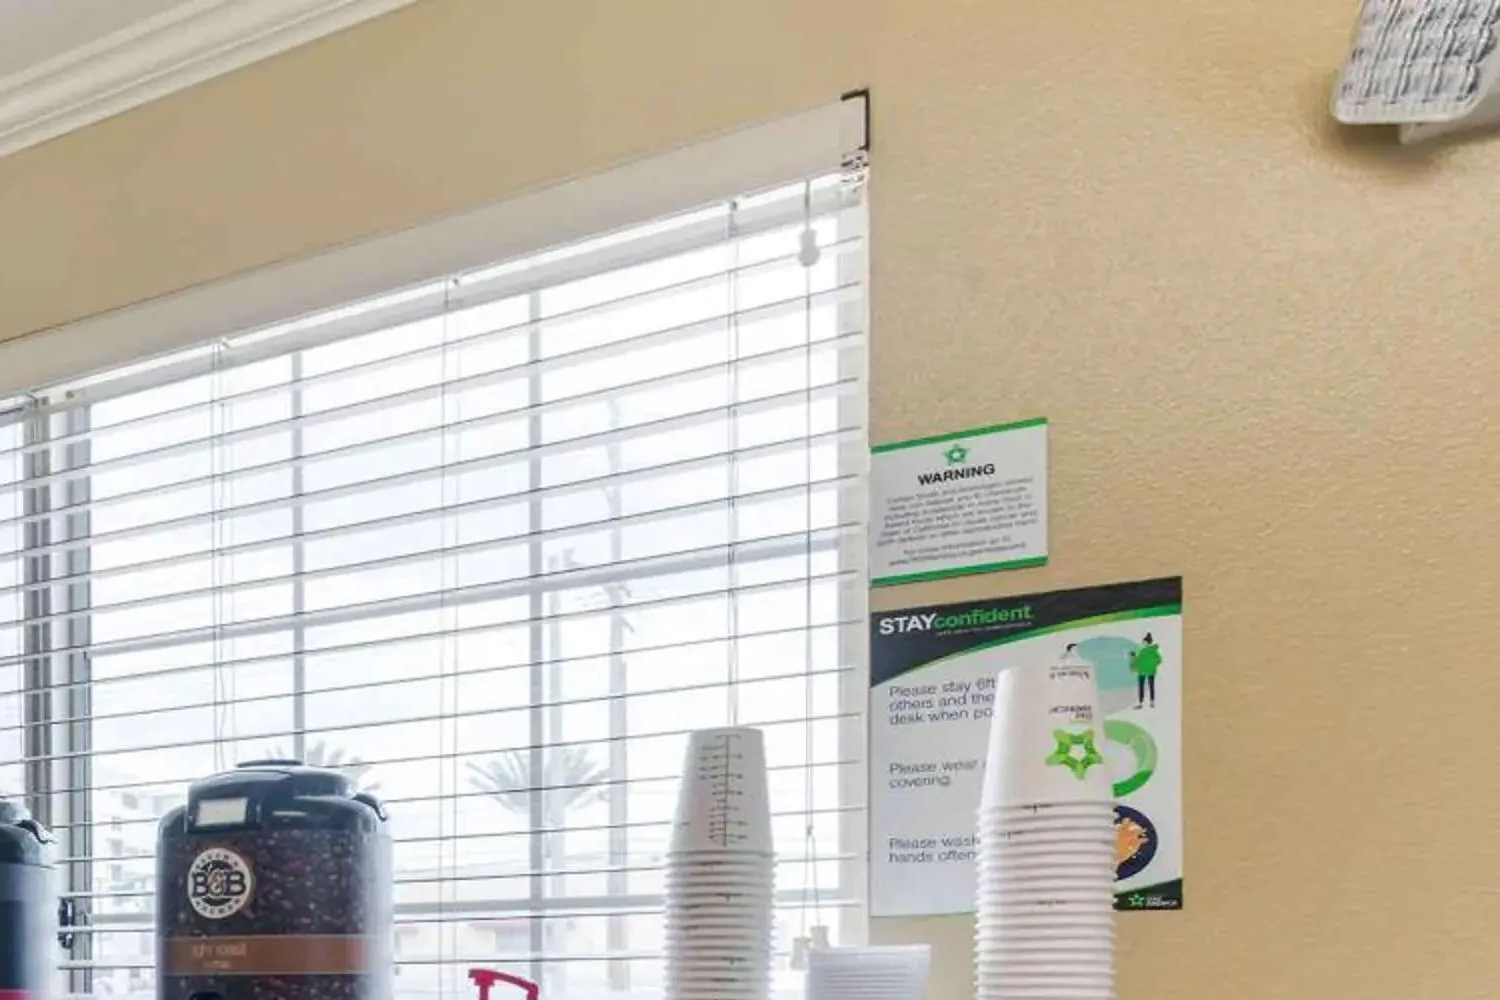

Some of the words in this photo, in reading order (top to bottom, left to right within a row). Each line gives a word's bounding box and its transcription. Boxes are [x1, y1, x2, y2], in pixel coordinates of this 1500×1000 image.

[918, 464, 996, 486] WARNING
[889, 685, 937, 696] Please
[941, 681, 971, 693] stay
[889, 698, 934, 712] others
[939, 694, 967, 706] and
[889, 712, 924, 725] desk
[927, 709, 969, 721] when
[889, 762, 937, 774] Please
[941, 760, 978, 771] wear
[889, 837, 937, 849] Please
[941, 833, 980, 847] wash
[889, 851, 934, 863] hands
